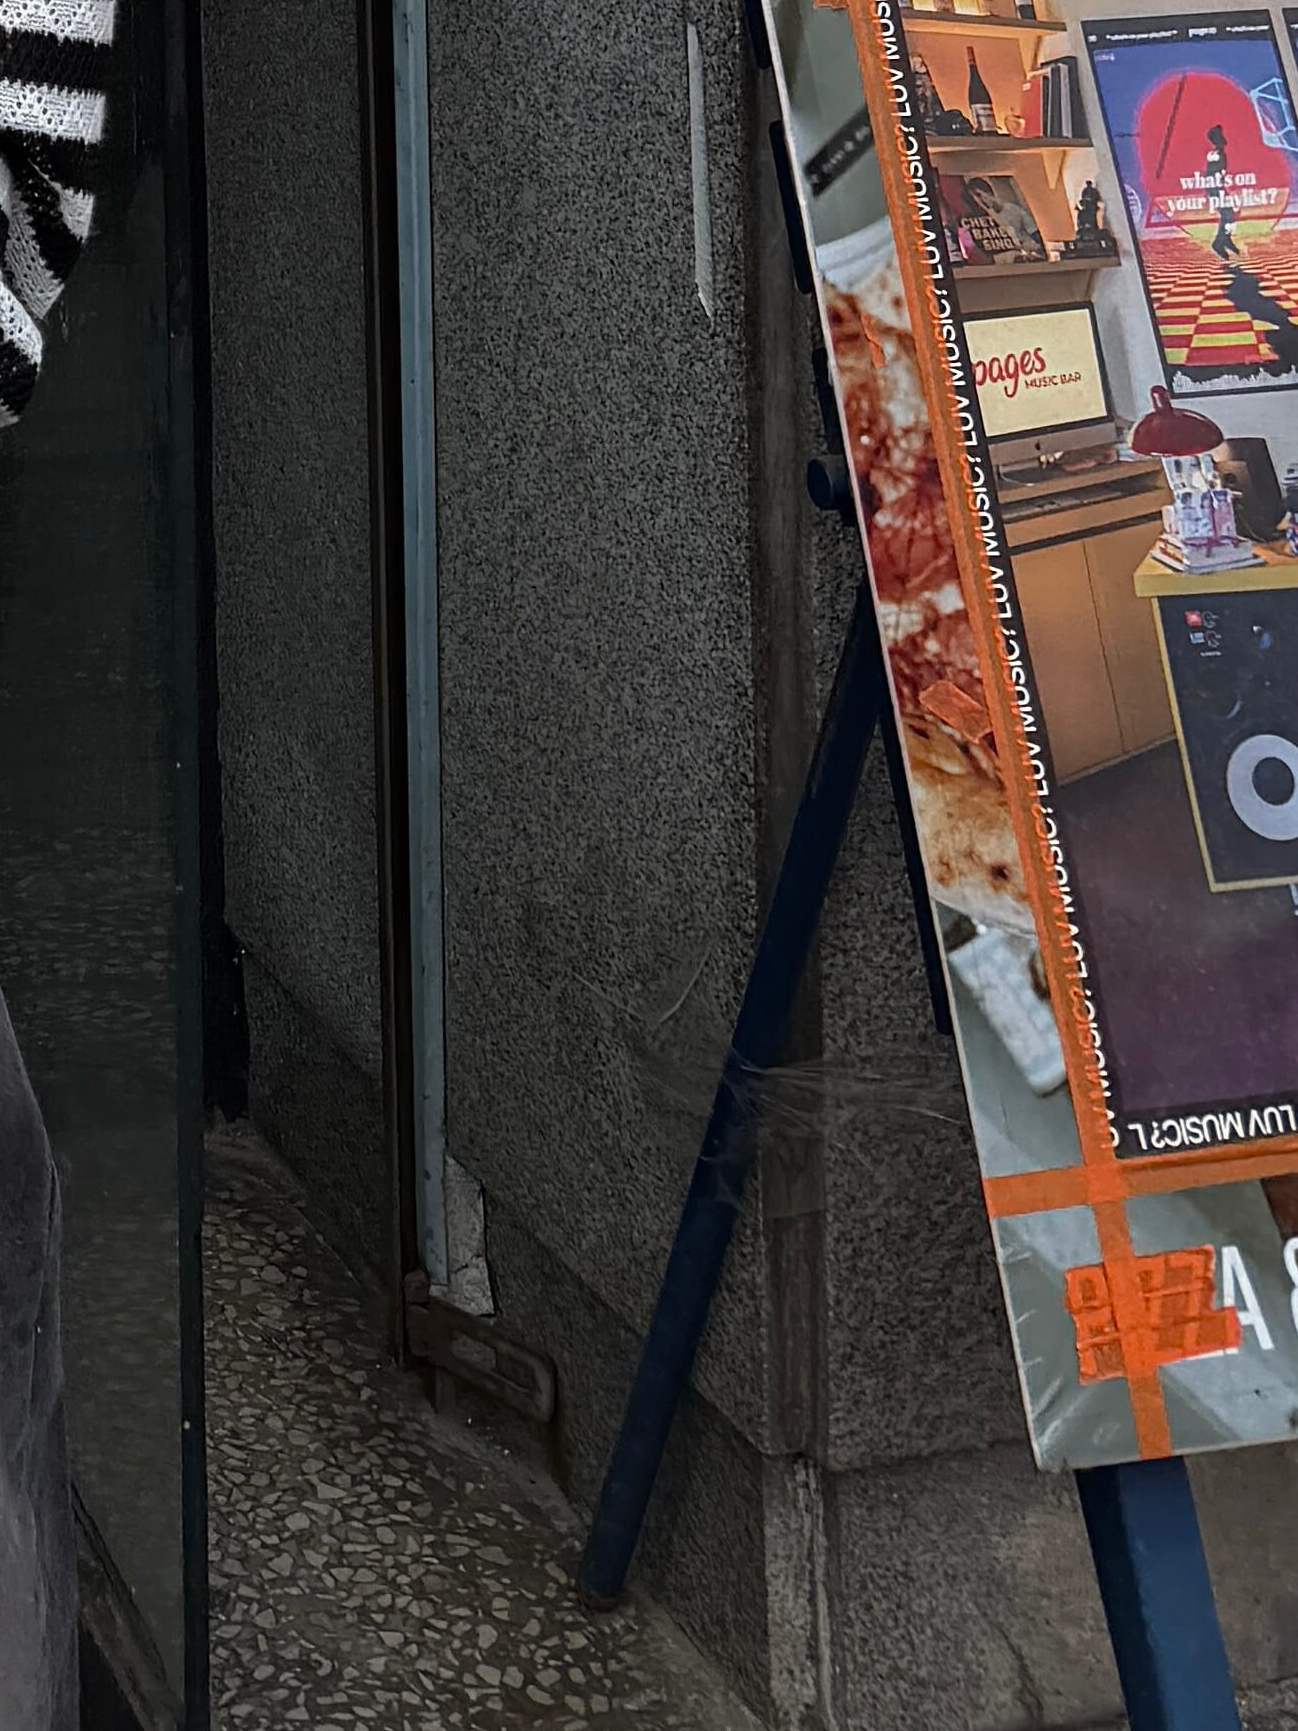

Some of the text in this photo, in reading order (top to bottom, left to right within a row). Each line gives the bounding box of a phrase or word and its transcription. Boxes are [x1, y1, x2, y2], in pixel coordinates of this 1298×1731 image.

[1234, 172, 1257, 186] on
[1166, 187, 1278, 218] your playlist?
[971, 346, 1047, 399] pages
[1024, 371, 1082, 390] MUSIC BAR
